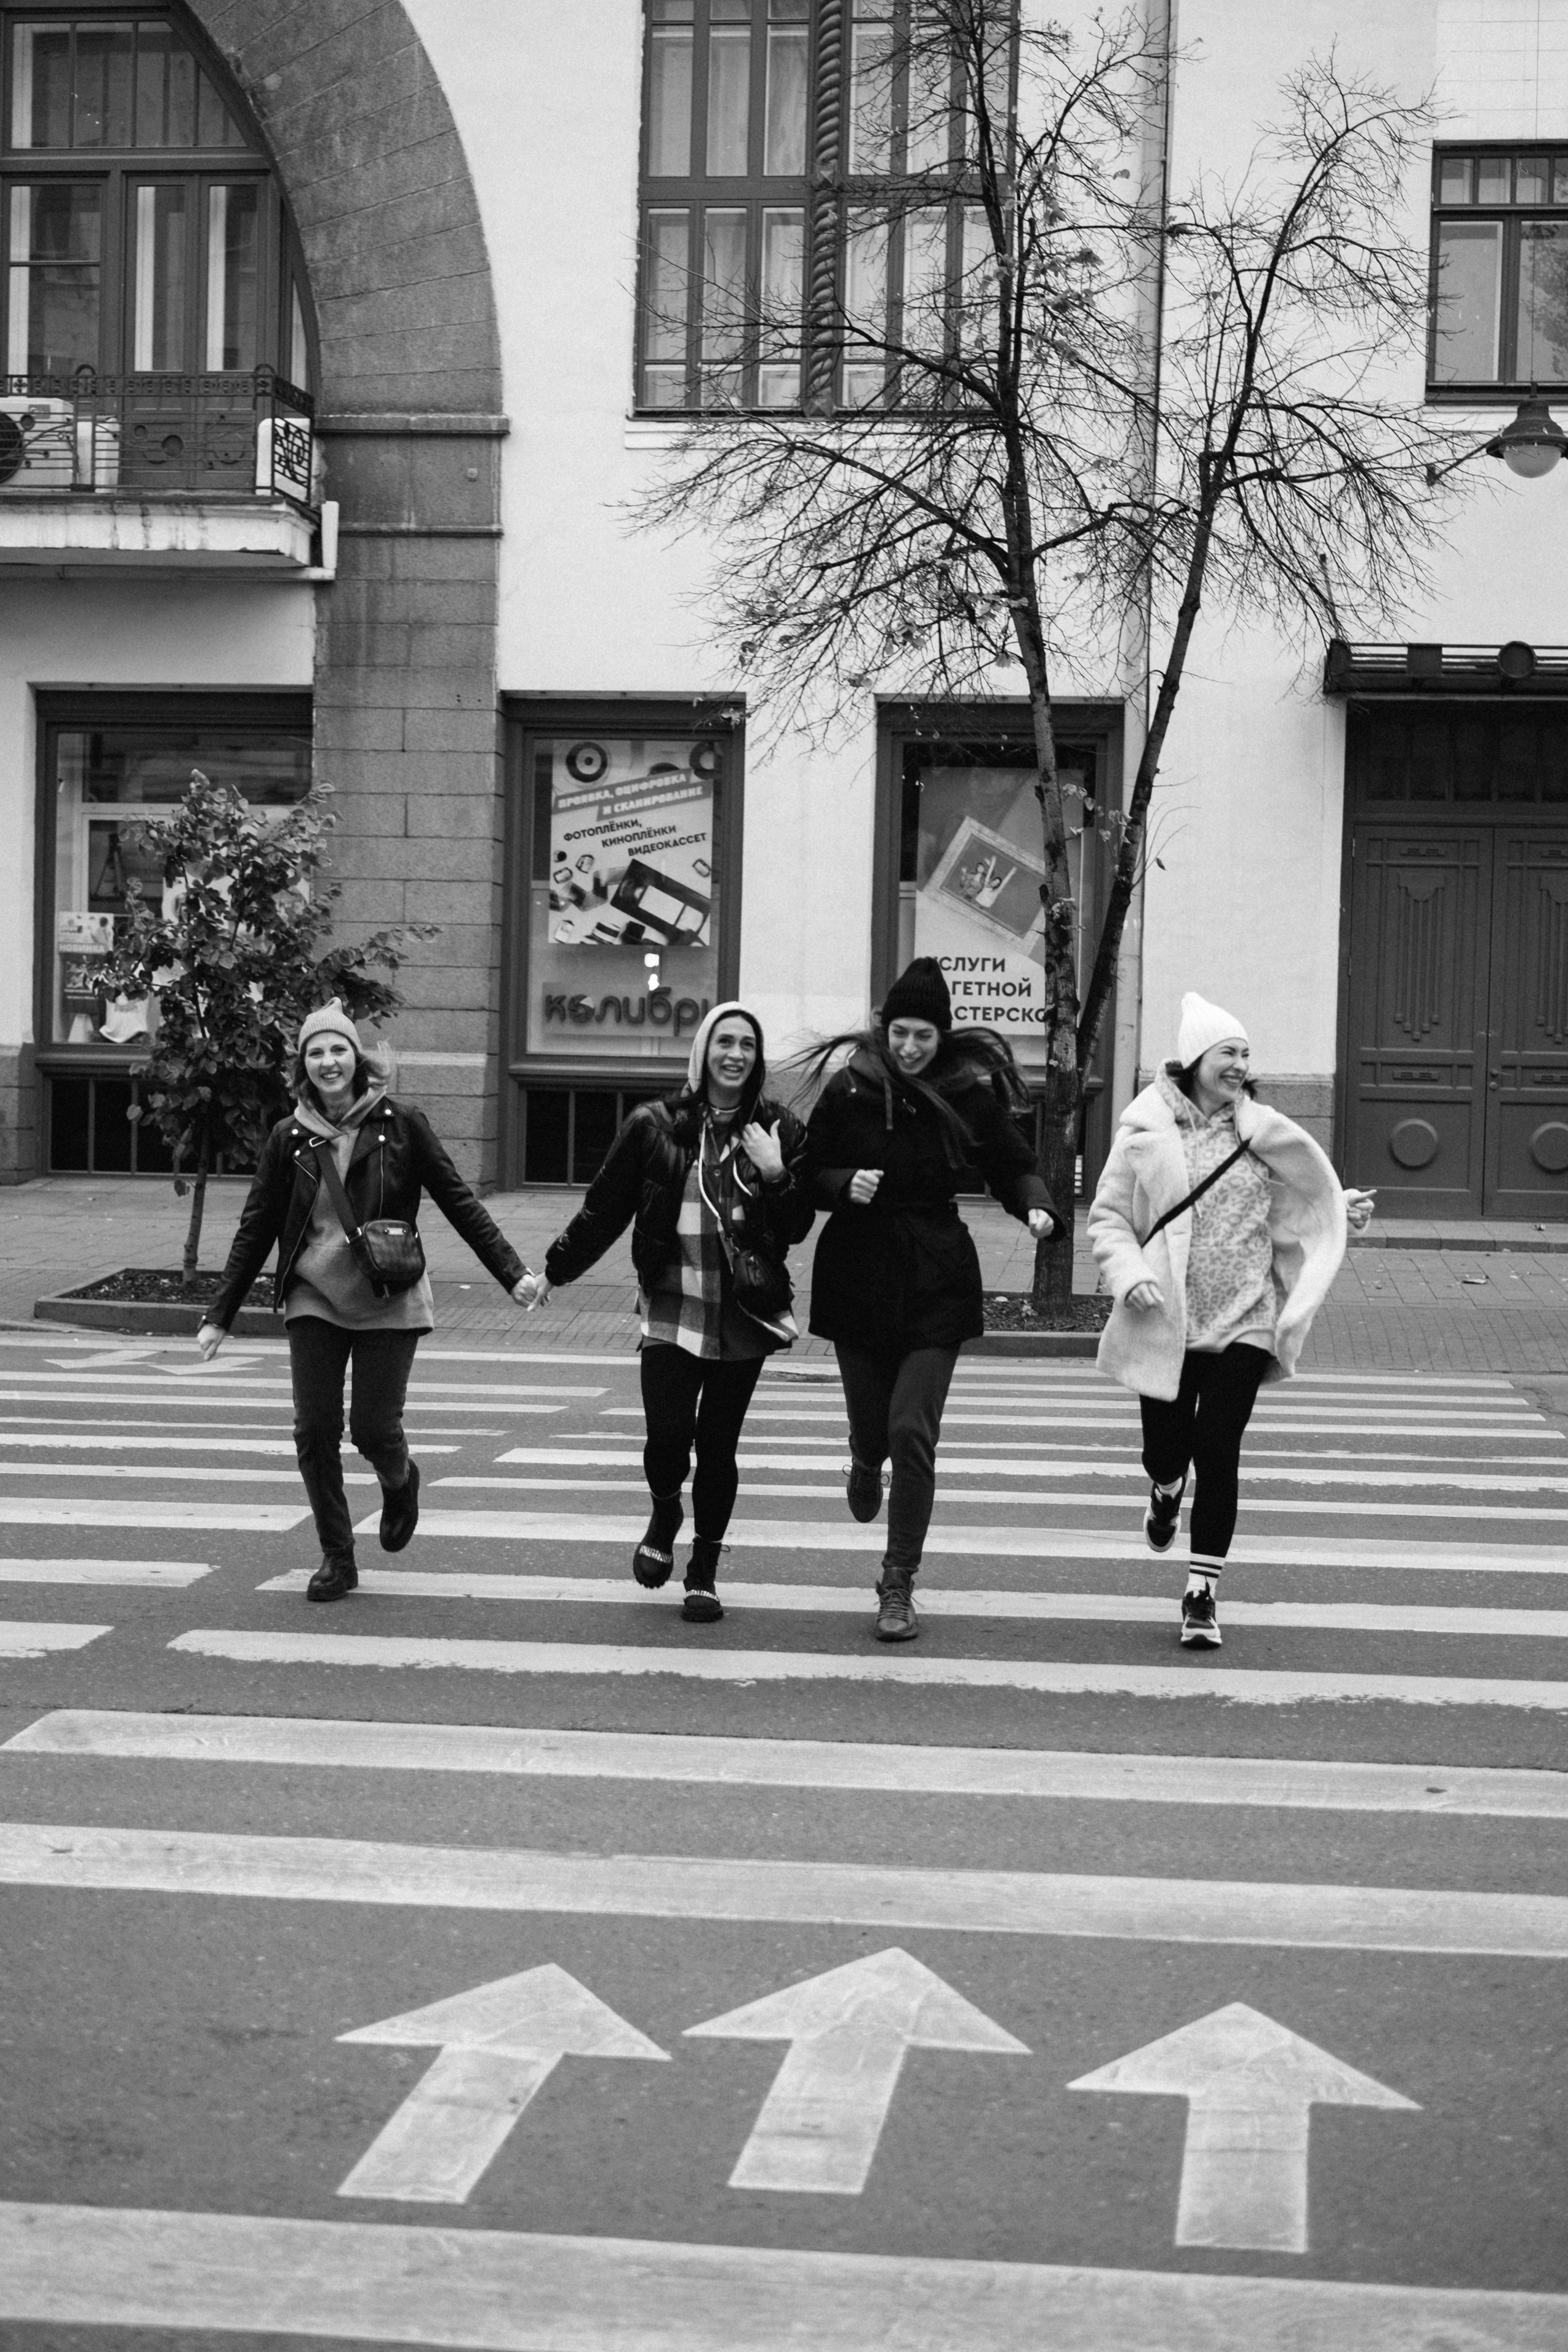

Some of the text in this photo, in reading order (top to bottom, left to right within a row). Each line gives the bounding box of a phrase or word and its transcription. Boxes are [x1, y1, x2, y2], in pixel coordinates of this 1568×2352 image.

[615, 773, 687, 796] ОЦИФРОВКА
[603, 786, 703, 815] И СКАНИРОВАНИЕ
[564, 818, 642, 842] ФОТОПЛЁНКИ,
[601, 825, 676, 848] КИНОПЛЁНКИ
[627, 832, 707, 856] ВИДЕОКАССЕТ
[935, 956, 1005, 973] СЛУГИ
[951, 977, 1031, 997] ГЕТНОЙ
[950, 1006, 1045, 1023] СТЕРСКО
